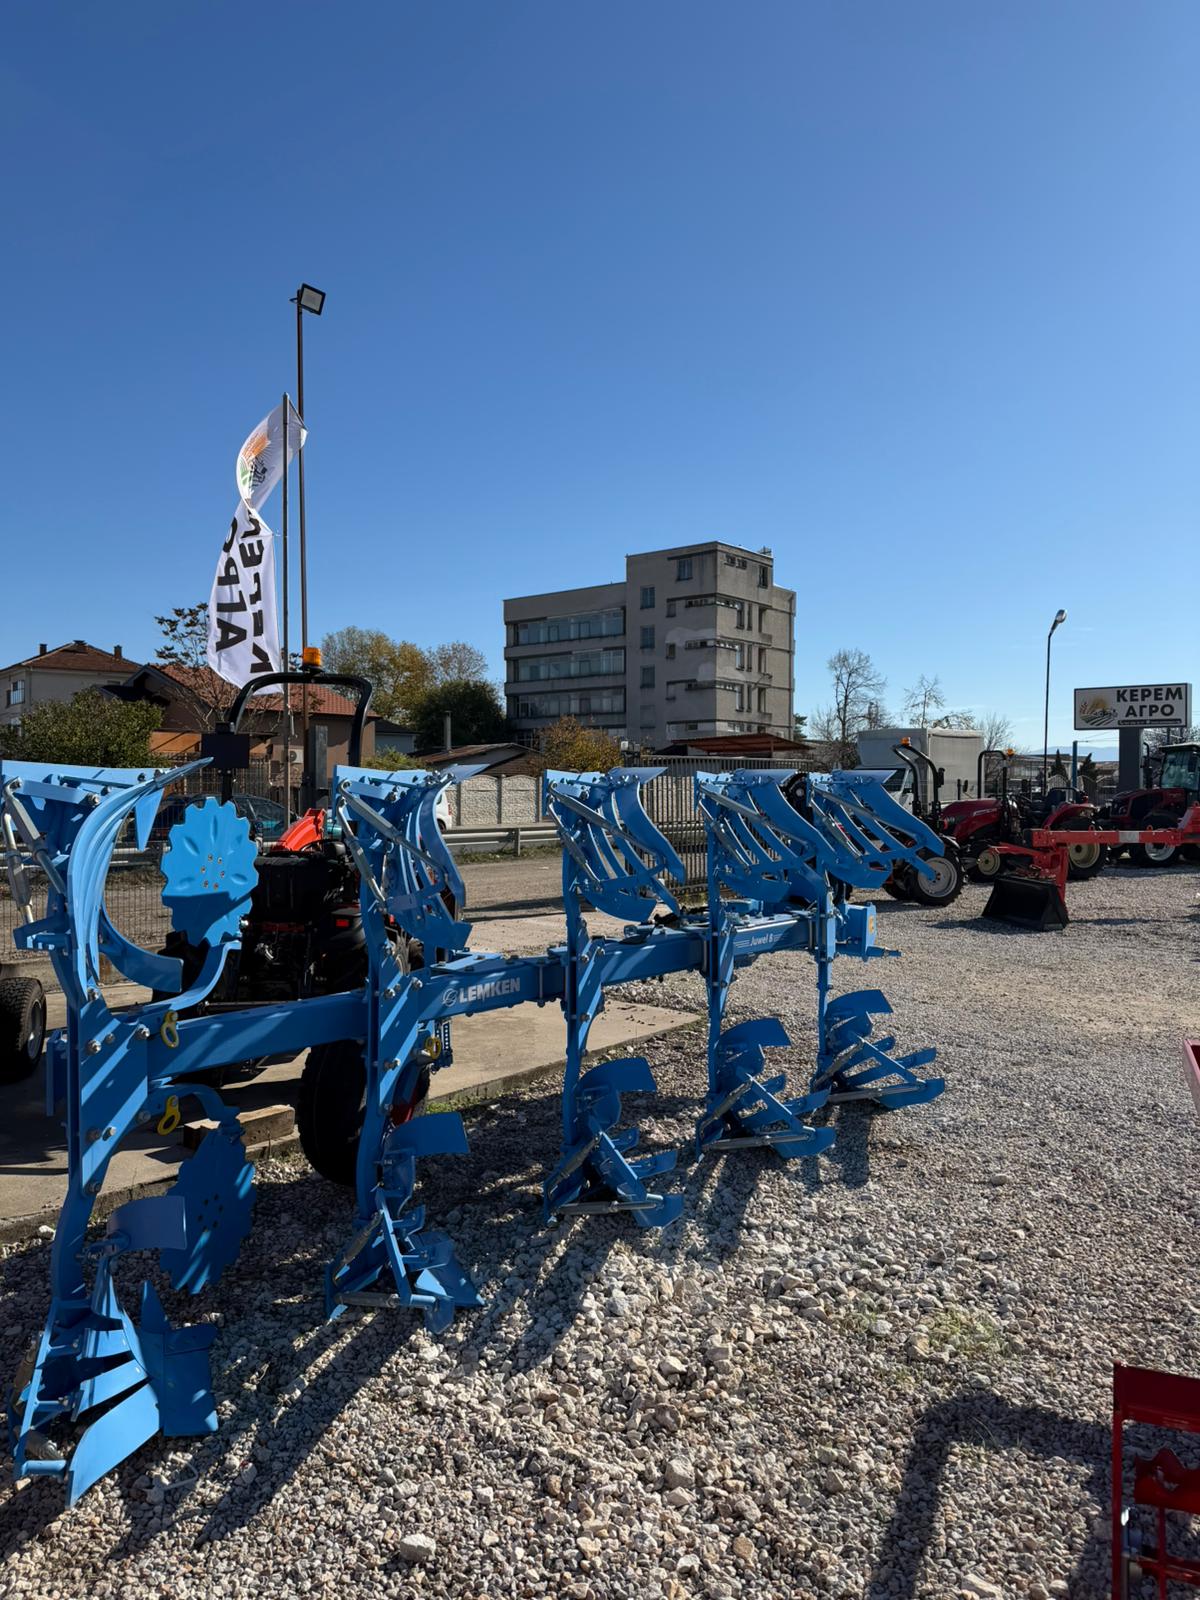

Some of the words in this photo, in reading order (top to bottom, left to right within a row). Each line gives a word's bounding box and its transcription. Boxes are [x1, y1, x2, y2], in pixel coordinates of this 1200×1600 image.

[1117, 687, 1183, 702] КЕРЕМ
[1125, 704, 1175, 718] АГРО
[459, 977, 521, 1003] LEMKEN
